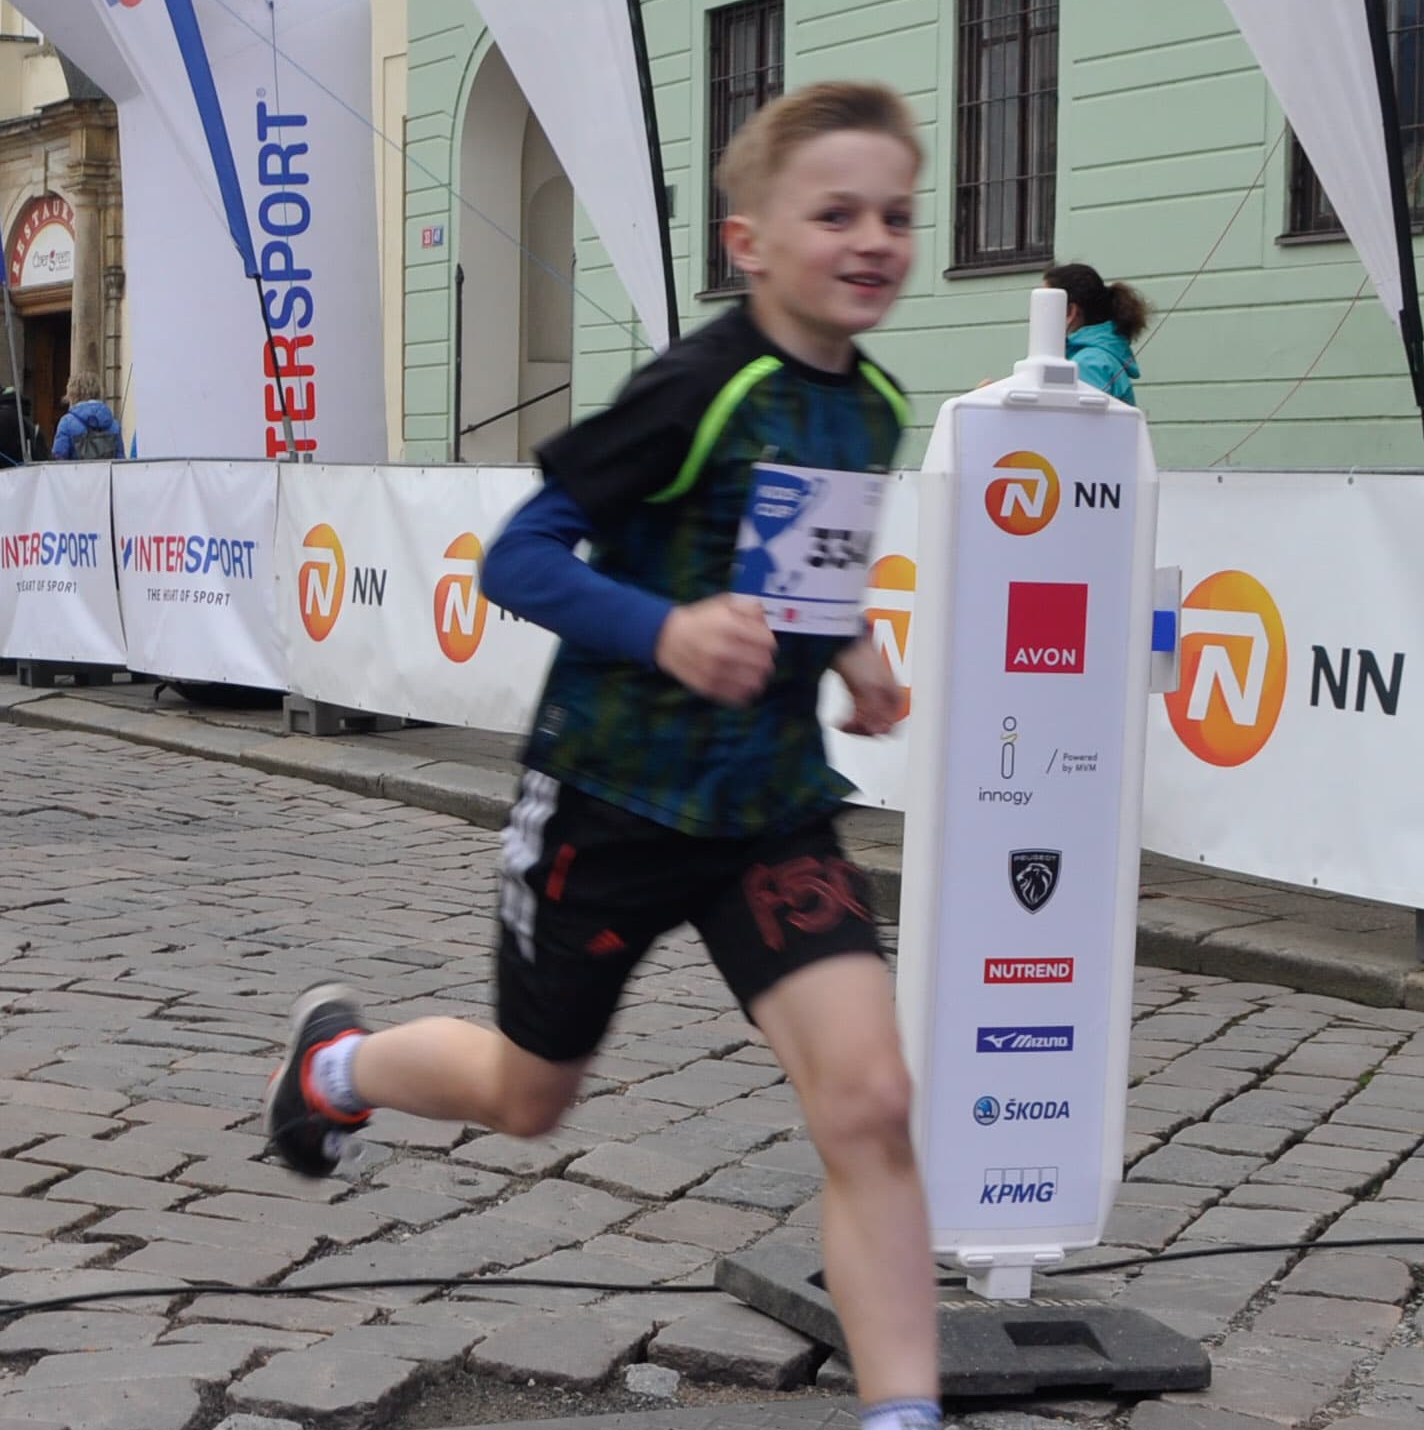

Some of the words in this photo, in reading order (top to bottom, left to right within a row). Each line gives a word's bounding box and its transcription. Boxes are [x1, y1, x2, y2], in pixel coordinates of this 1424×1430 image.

[257, 102, 317, 459] TERSPORT
[1075, 482, 1121, 509] NN
[135, 535, 255, 579] INTERSPORT
[47, 580, 77, 594] SPORT
[147, 588, 160, 602] THE
[193, 590, 231, 606] SPORT
[352, 567, 387, 606] NN
[1013, 648, 1076, 665] AVON
[1311, 645, 1405, 715] NN
[978, 787, 1033, 805] innogy
[988, 962, 1069, 979] NUTREND
[1004, 1098, 1070, 1121] ŠKODA
[979, 1181, 1055, 1204] KPMG
